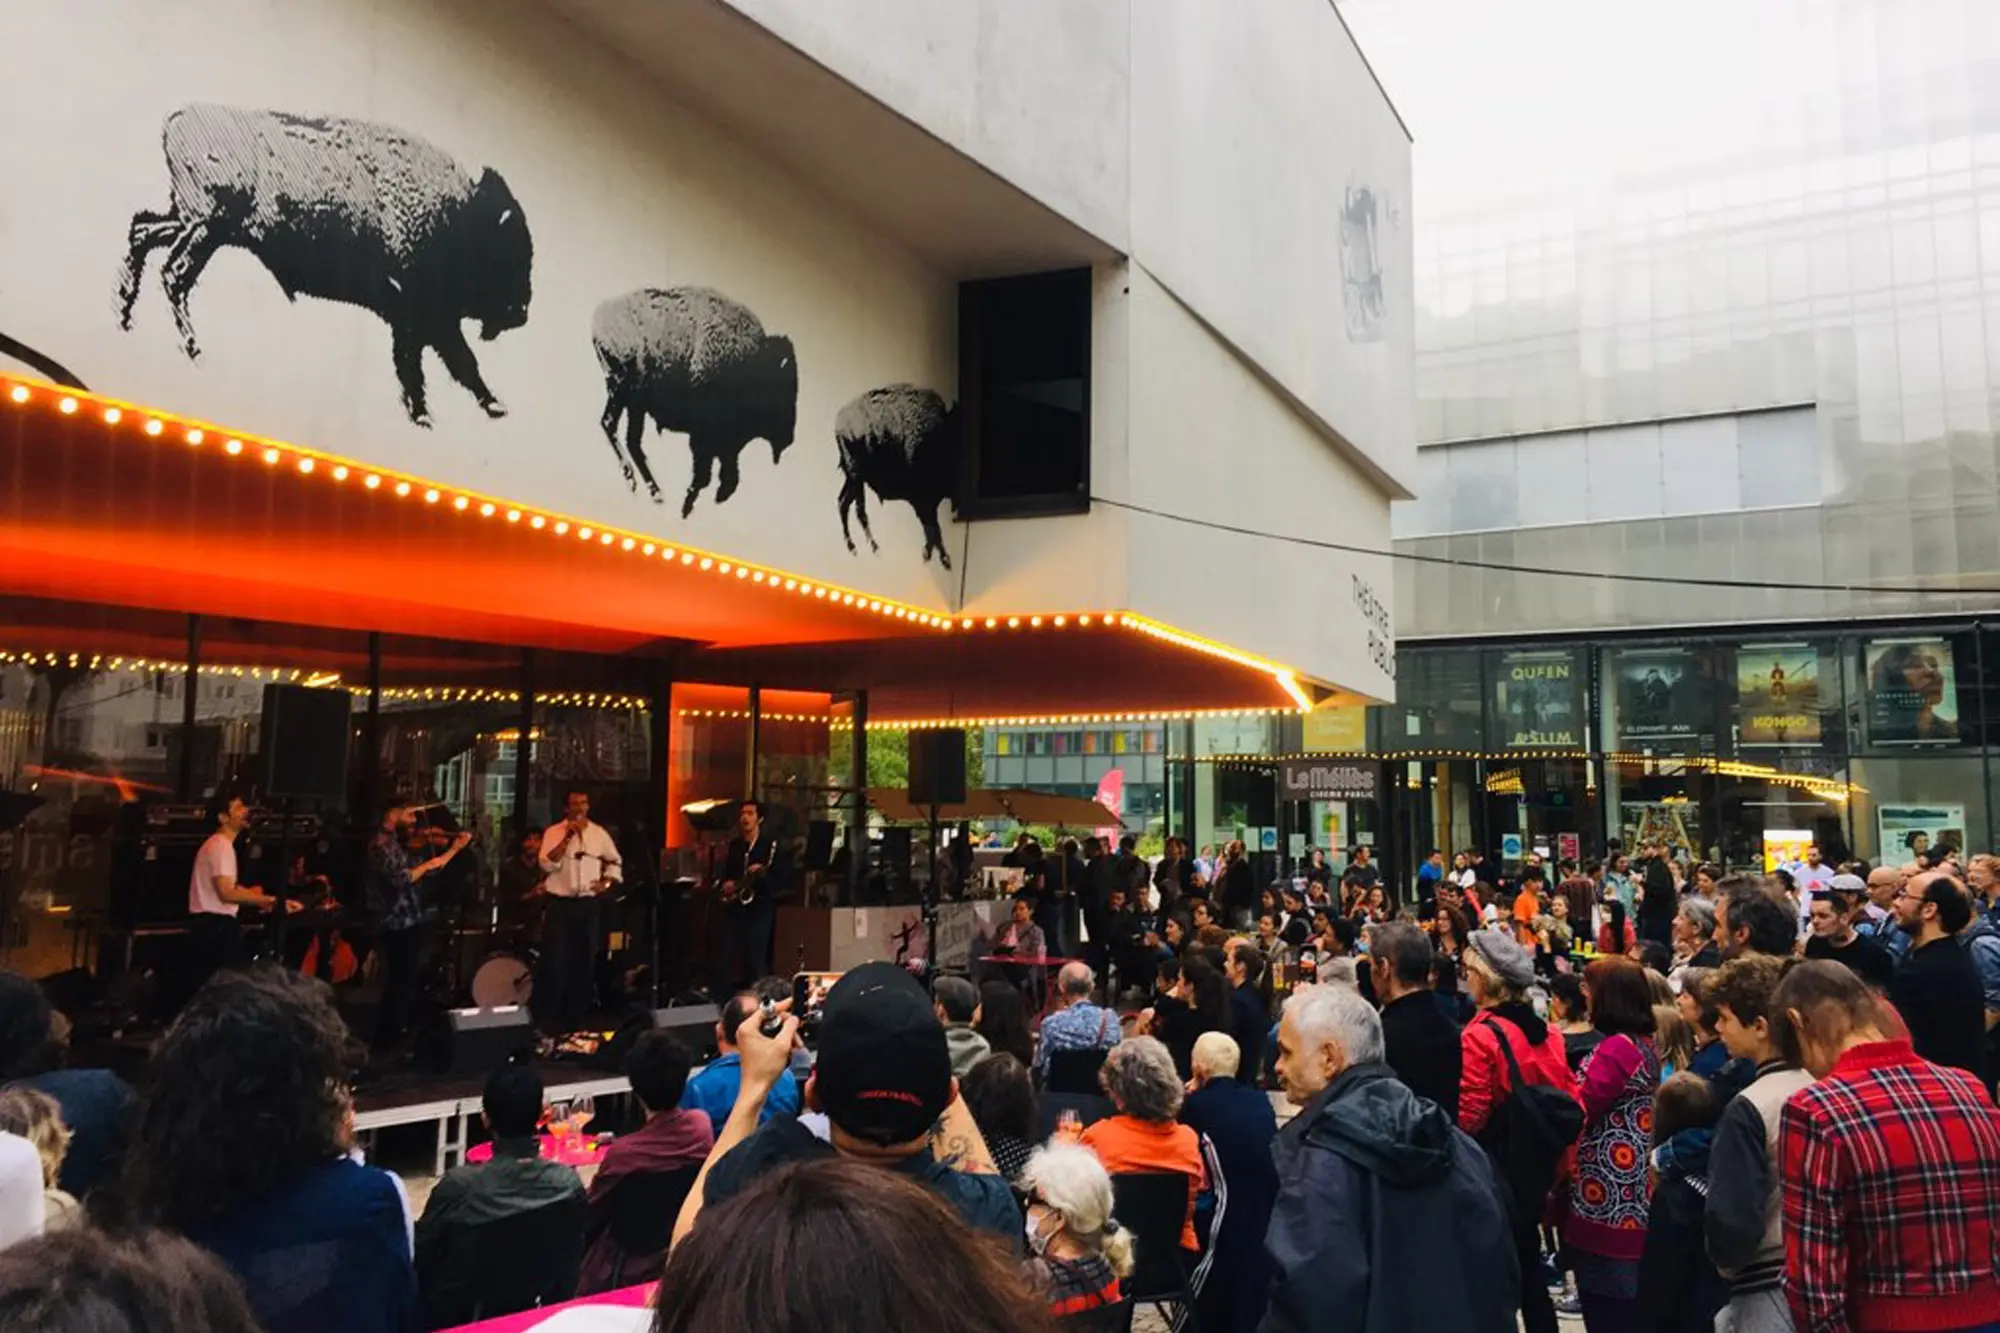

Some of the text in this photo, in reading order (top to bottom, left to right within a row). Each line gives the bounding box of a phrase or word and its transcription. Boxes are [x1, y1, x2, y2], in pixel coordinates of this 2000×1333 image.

[1511, 665, 1569, 680] QUEEN
[1752, 715, 1808, 729] KONGO
[1286, 767, 1309, 790] Le
